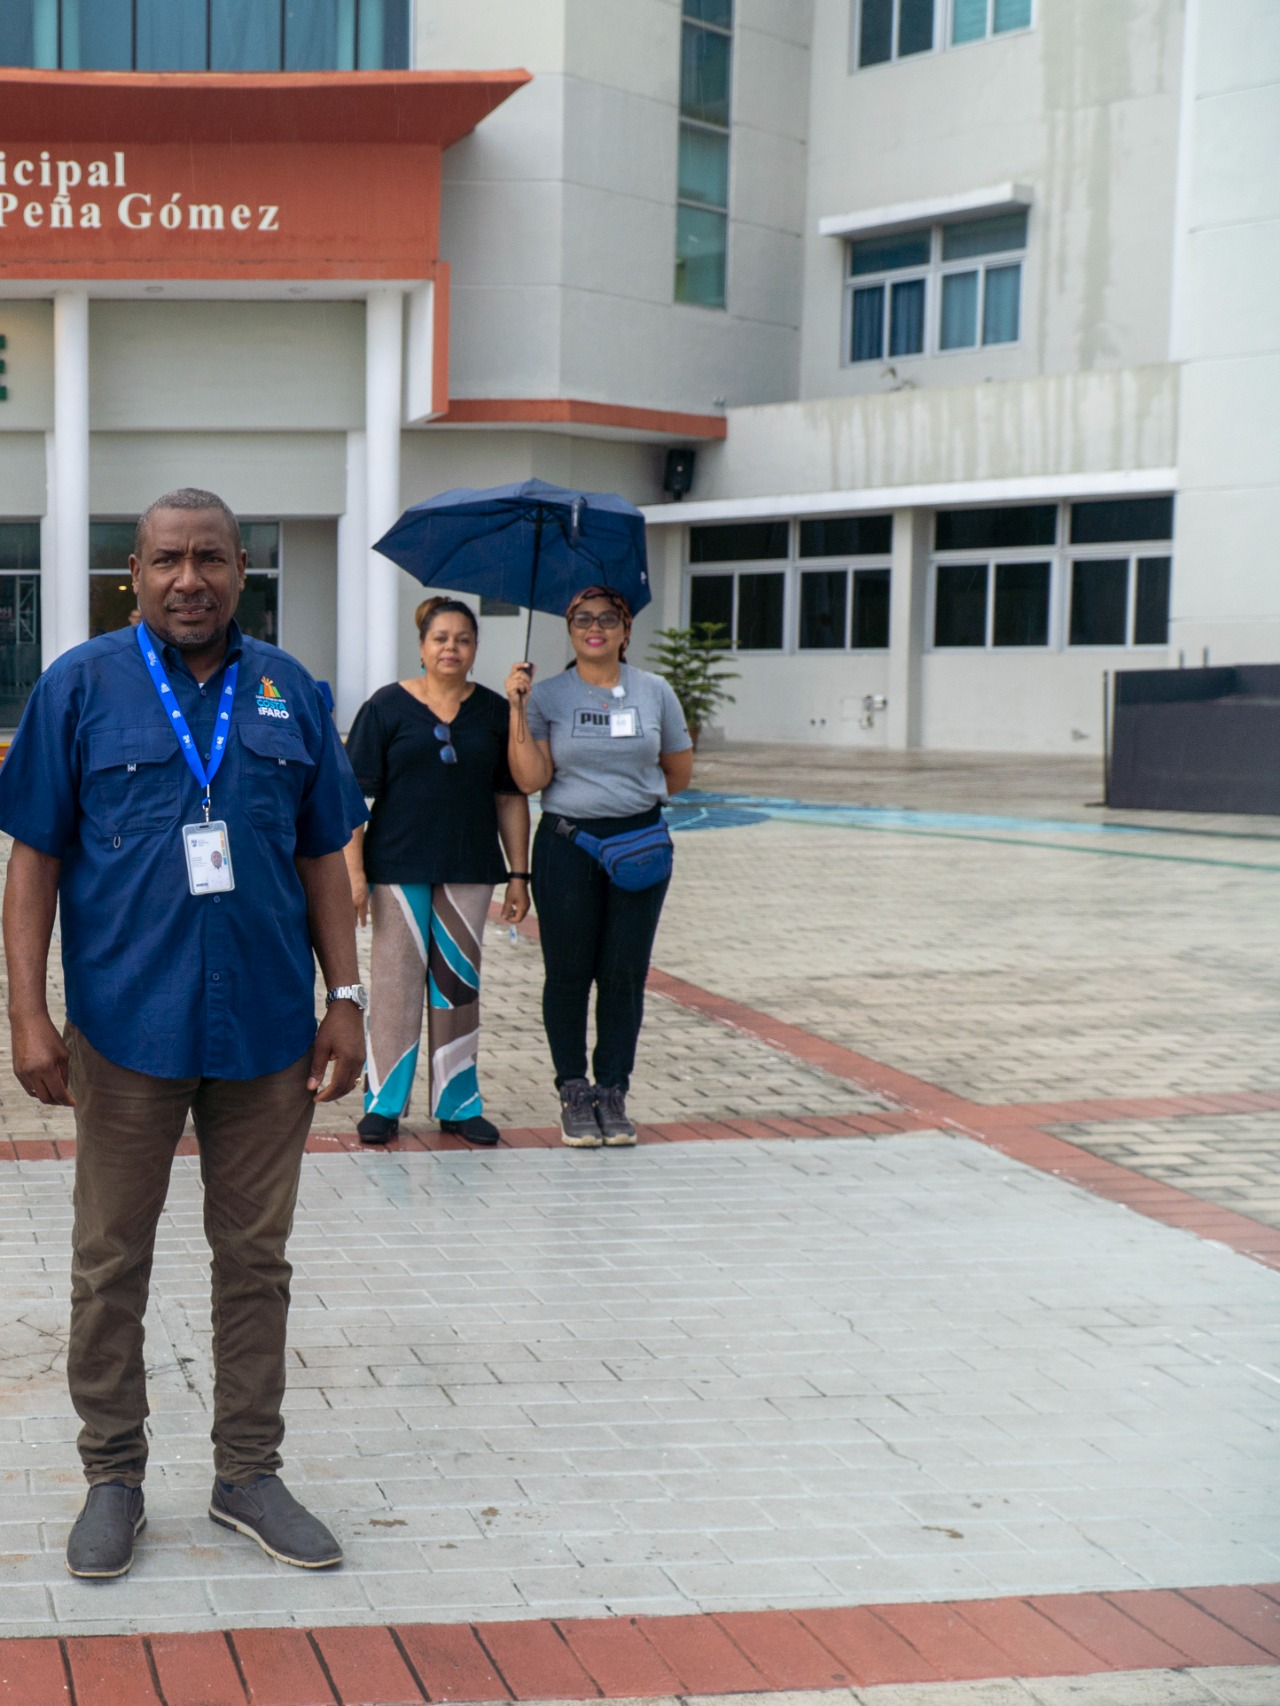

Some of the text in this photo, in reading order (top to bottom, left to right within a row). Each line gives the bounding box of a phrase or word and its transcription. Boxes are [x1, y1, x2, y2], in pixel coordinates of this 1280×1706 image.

[118, 192, 280, 231] Gómez
[256, 699, 287, 711] COSTA
[261, 706, 289, 719] FARO
